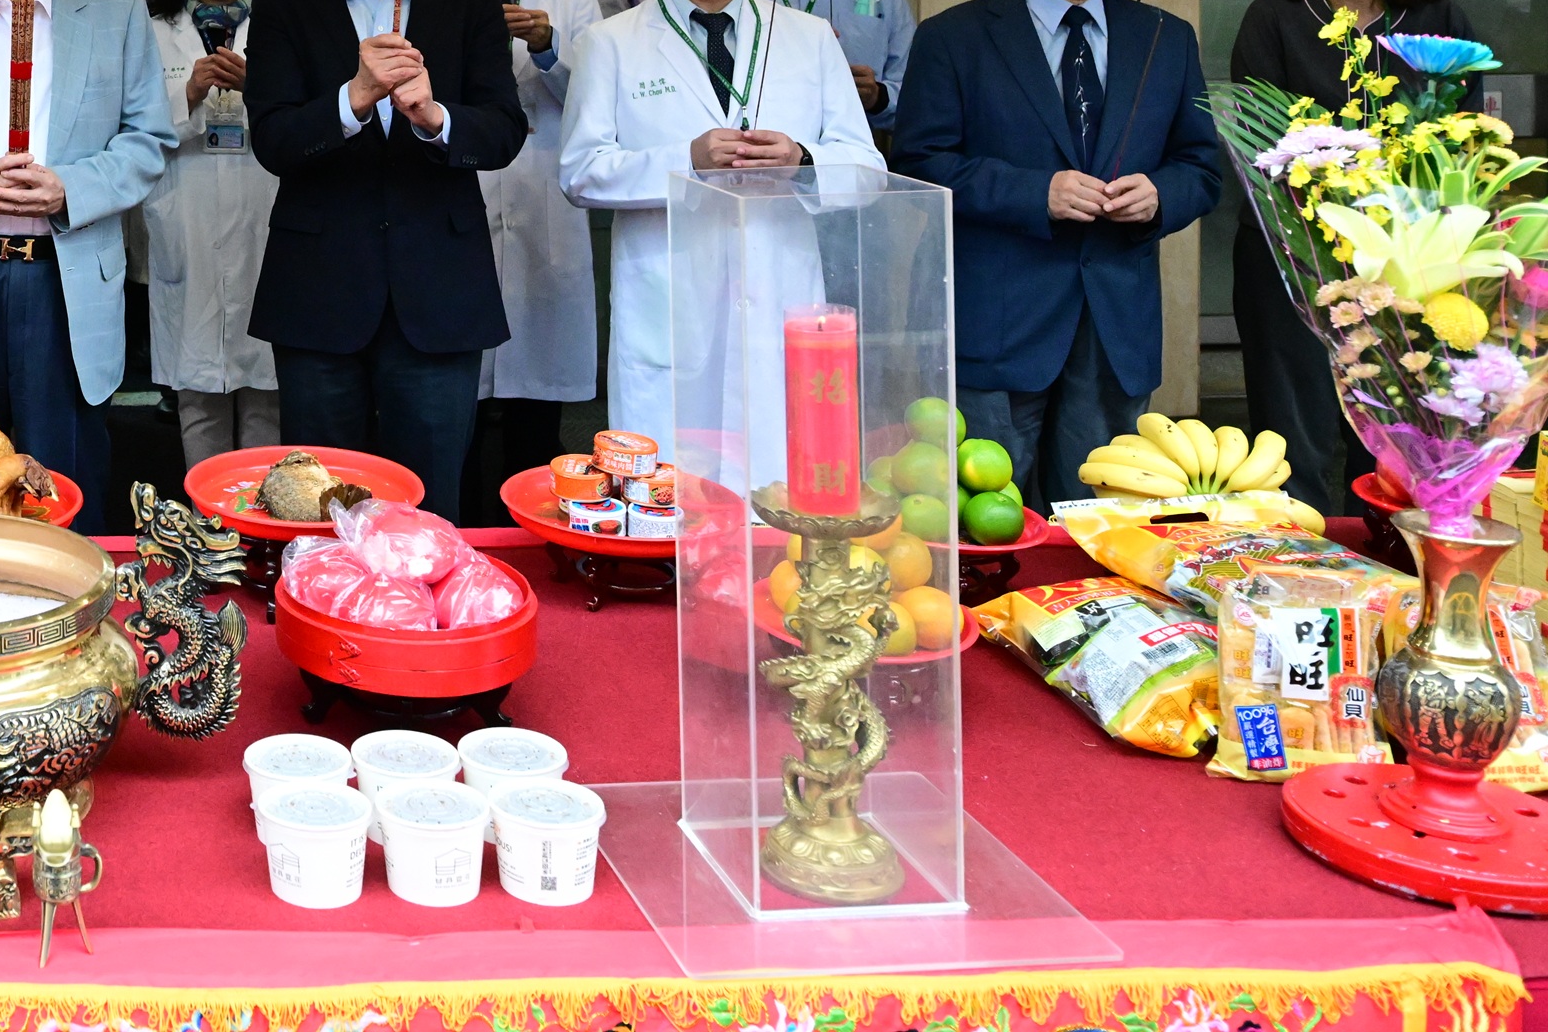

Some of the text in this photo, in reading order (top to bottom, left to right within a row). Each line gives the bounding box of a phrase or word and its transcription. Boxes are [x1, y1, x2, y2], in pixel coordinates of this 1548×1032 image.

[1289, 614, 1336, 691] 旺旺
[1237, 705, 1275, 722] 100%
[1345, 687, 1365, 719] 仙貝
[1255, 716, 1280, 756] 台灣
